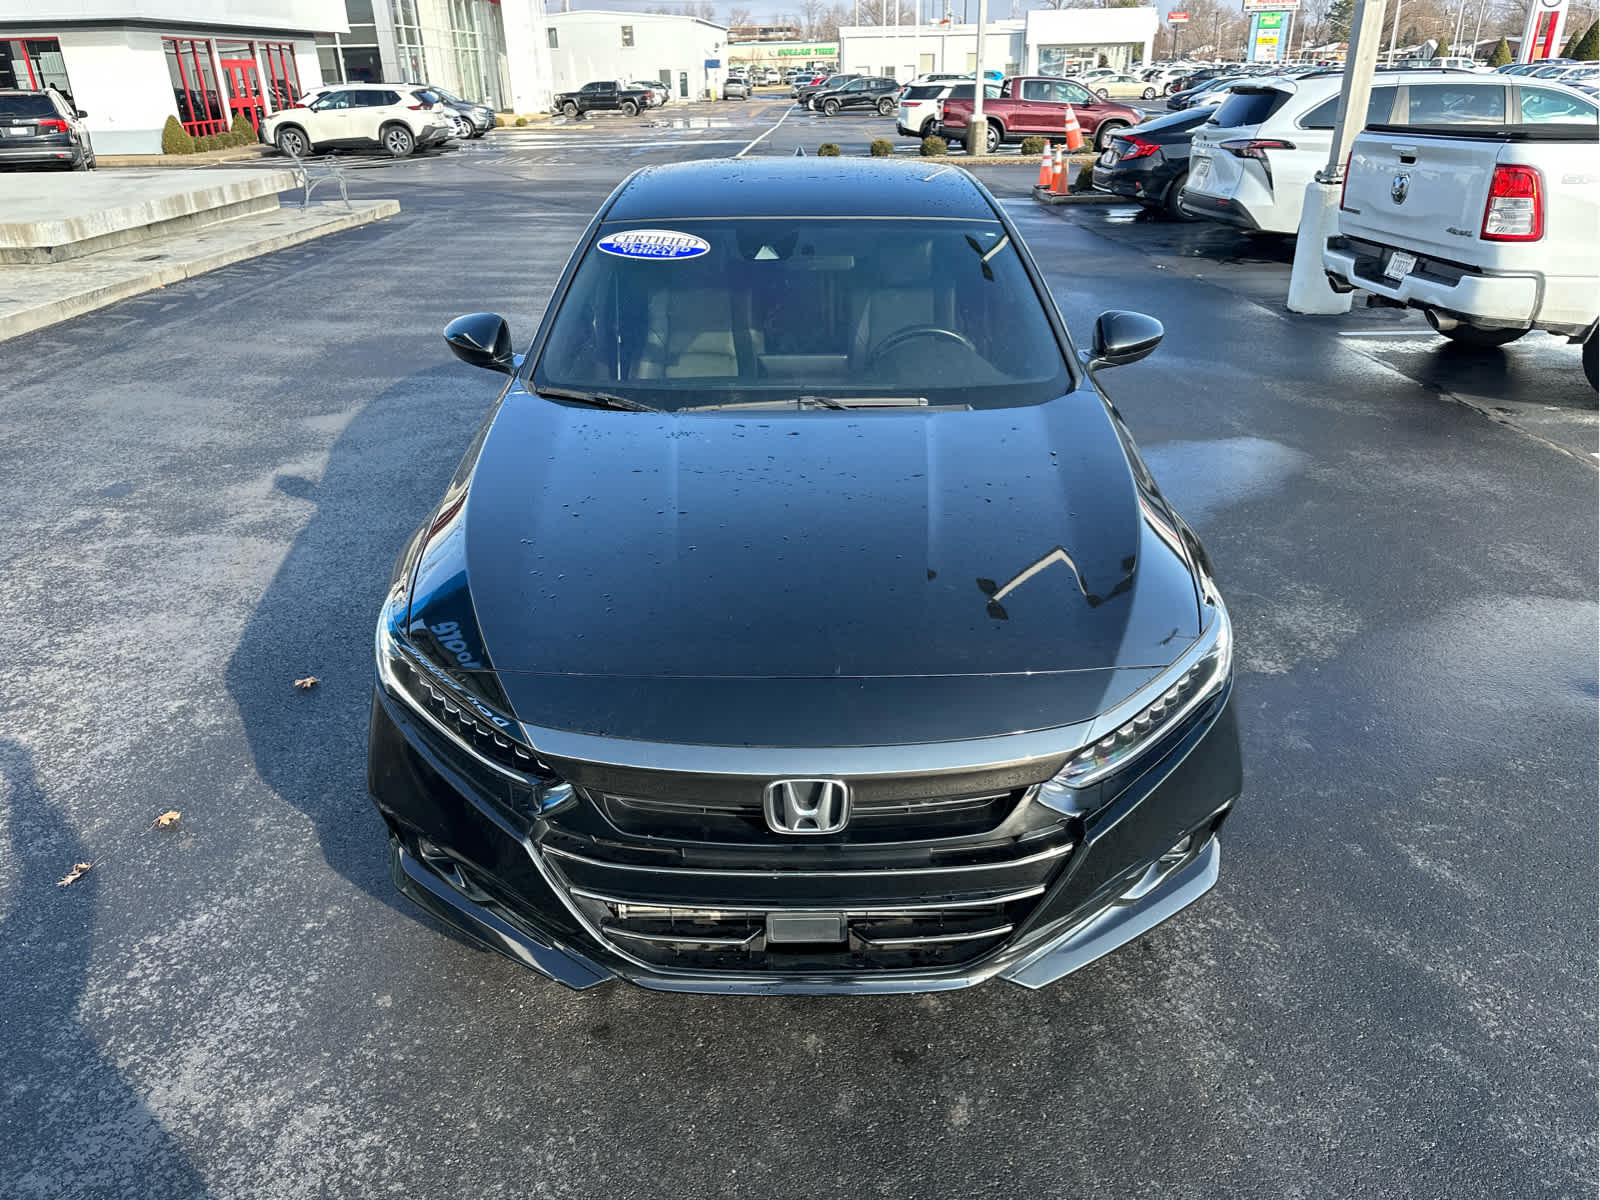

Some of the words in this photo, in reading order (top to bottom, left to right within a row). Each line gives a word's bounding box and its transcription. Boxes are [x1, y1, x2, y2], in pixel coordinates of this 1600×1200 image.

[613, 234, 698, 247] CERTIFIED
[612, 241, 690, 253] PRE-OWNED
[622, 247, 677, 256] VEHICLE
